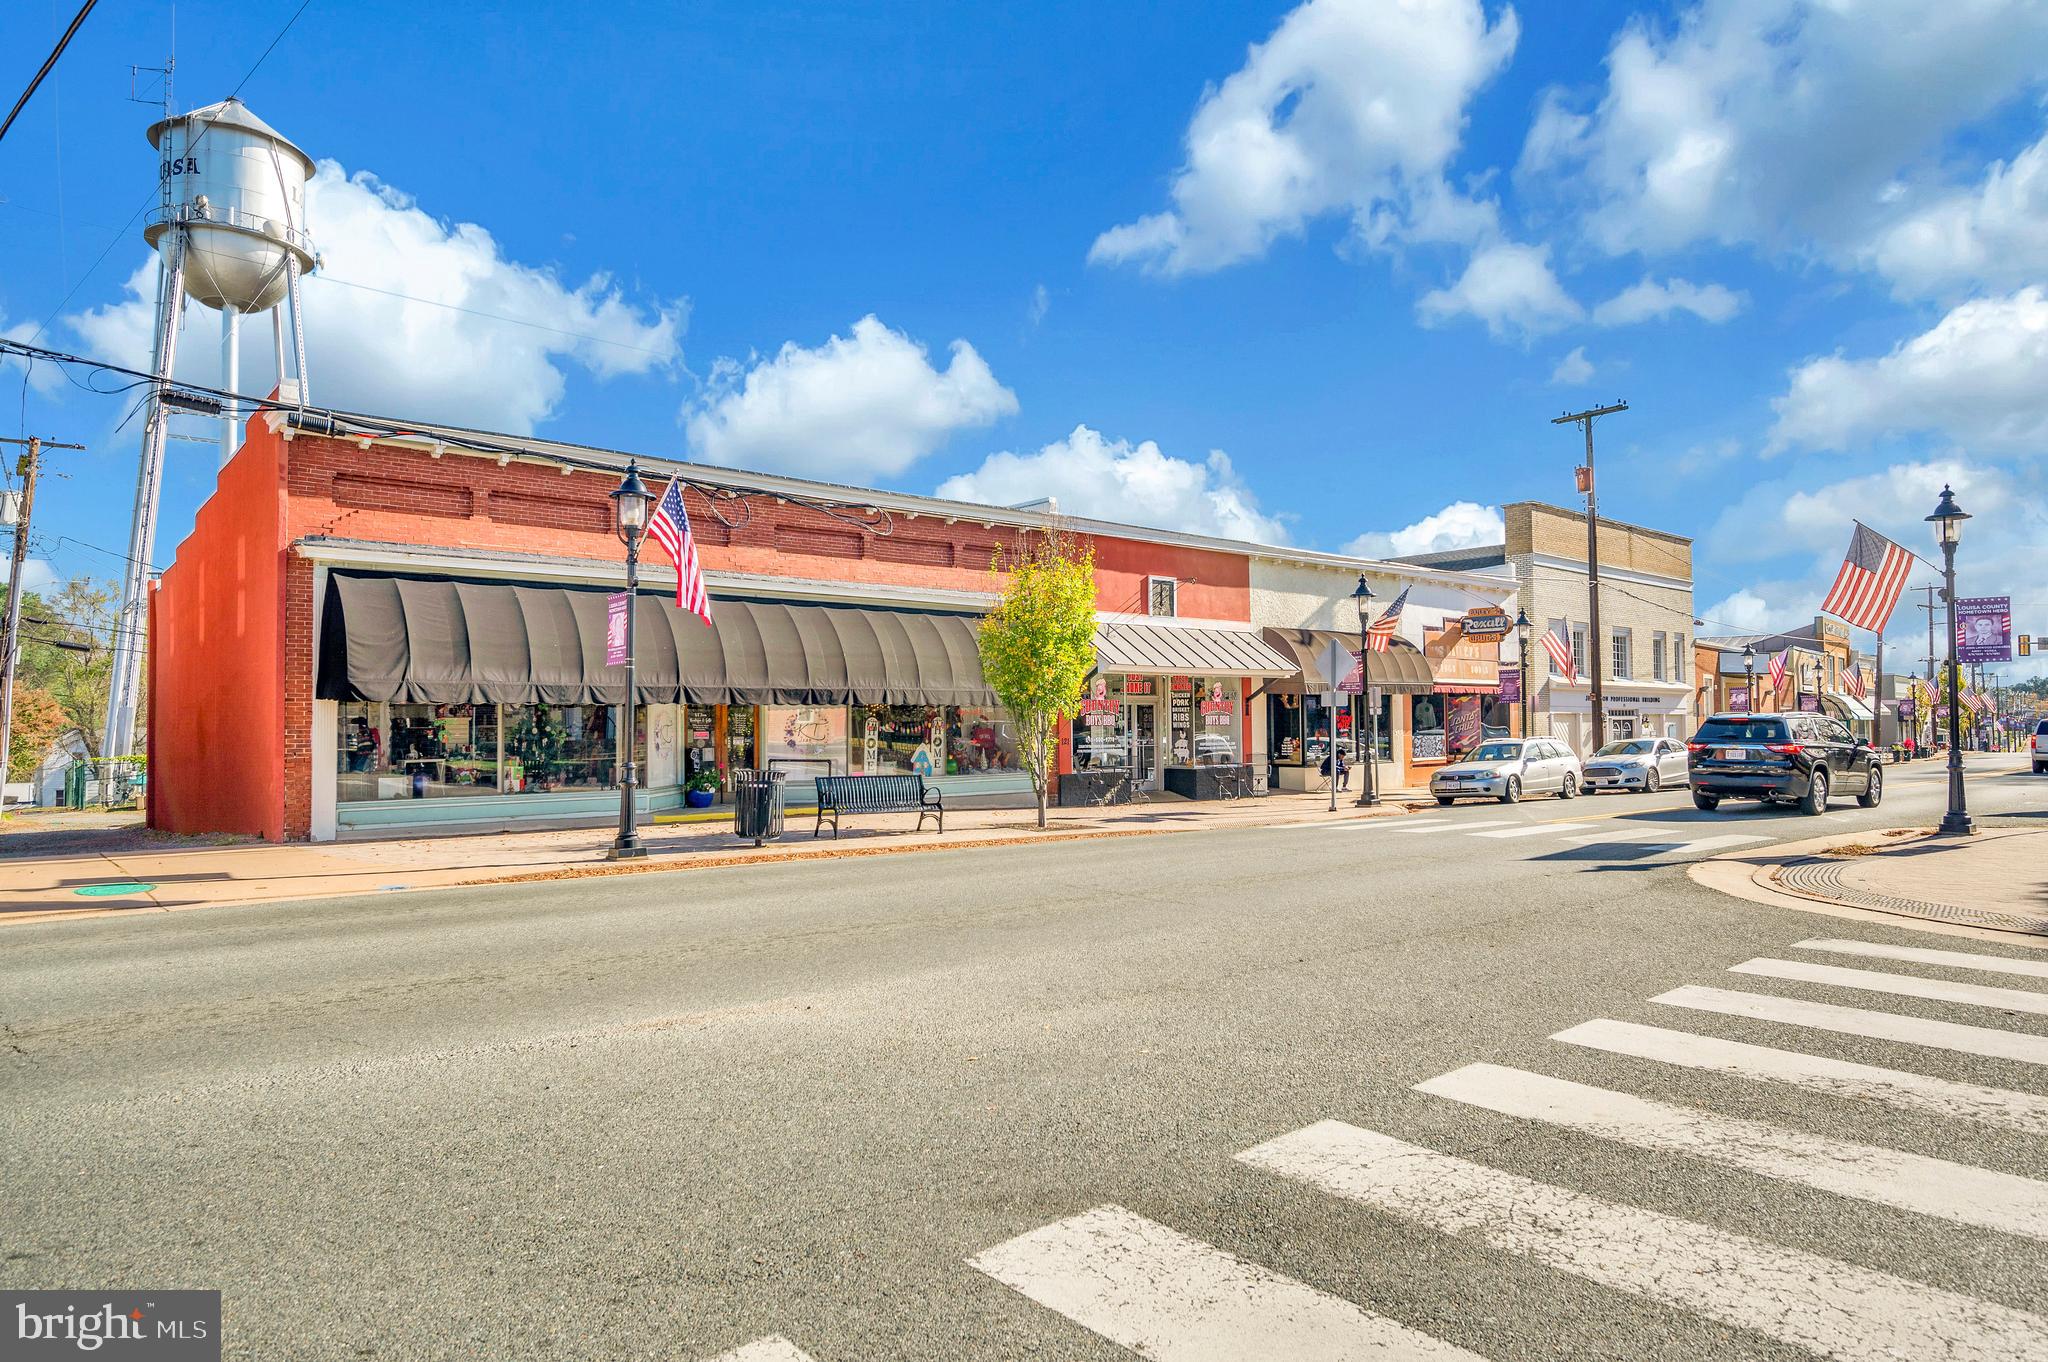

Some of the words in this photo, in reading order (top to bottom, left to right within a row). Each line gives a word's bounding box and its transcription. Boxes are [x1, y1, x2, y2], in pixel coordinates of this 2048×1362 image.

[1462, 616, 1506, 634] Rexall
[1172, 699, 1190, 707] PORK
[1172, 713, 1190, 721] RIBS
[1450, 712, 1475, 727] SANTA
[1455, 721, 1475, 734] CRUZ
